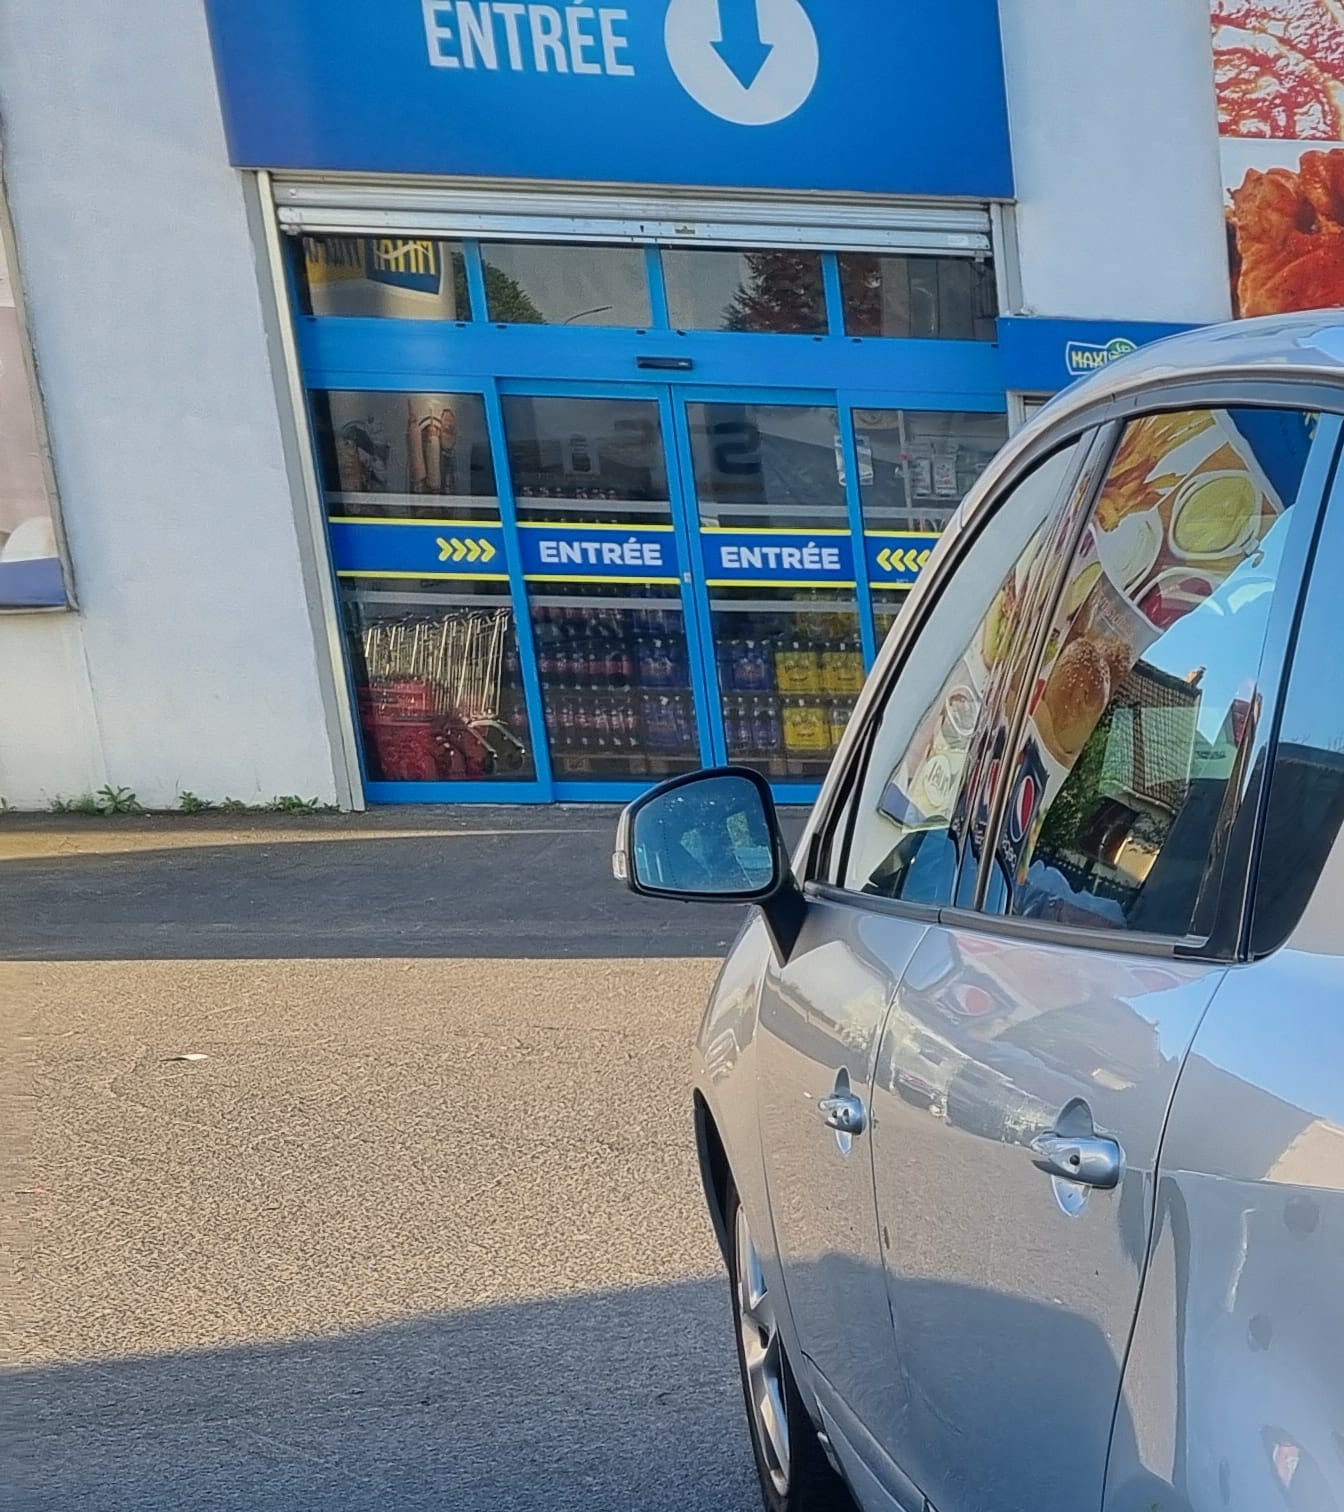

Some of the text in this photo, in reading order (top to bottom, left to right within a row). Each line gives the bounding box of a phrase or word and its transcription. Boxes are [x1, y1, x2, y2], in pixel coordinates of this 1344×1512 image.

[422, 0, 635, 76] ENTRÉE
[539, 537, 663, 566] ENTRÉE
[720, 541, 841, 570] ENTRÉE
